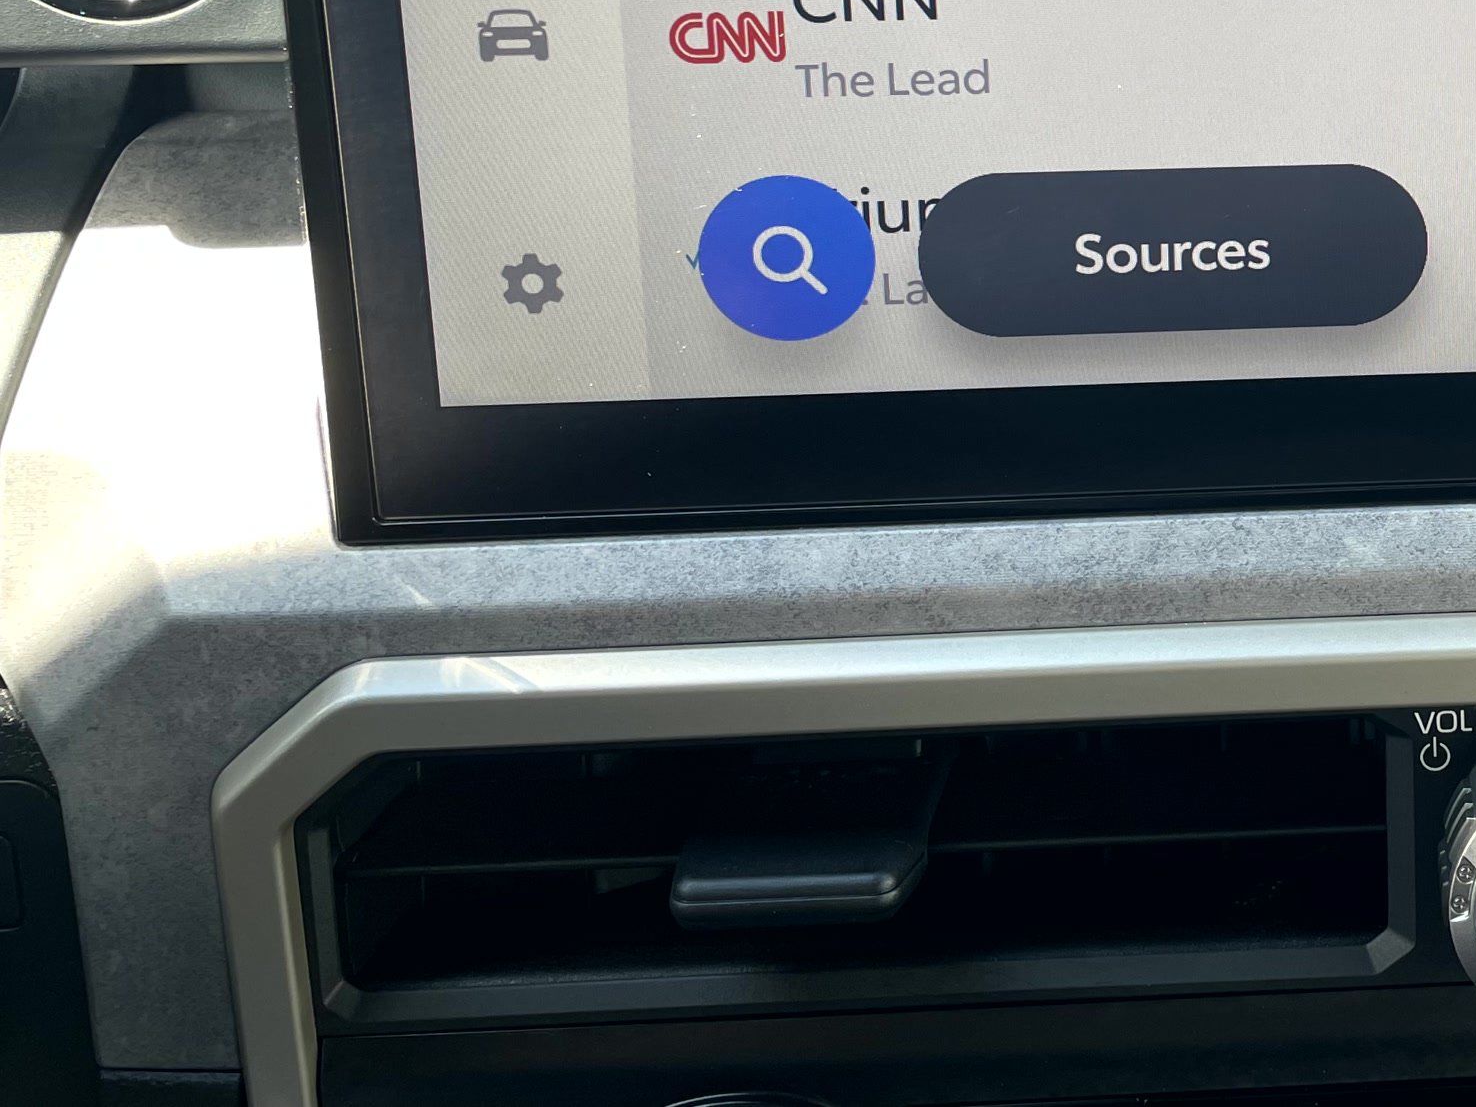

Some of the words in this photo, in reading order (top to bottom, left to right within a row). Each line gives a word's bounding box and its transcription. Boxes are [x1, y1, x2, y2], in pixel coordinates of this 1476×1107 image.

[669, 10, 787, 65] CNN
[795, 61, 875, 98] The
[888, 58, 991, 96] Lead
[1072, 231, 1271, 275] Sources
[1414, 709, 1473, 734] VOL
